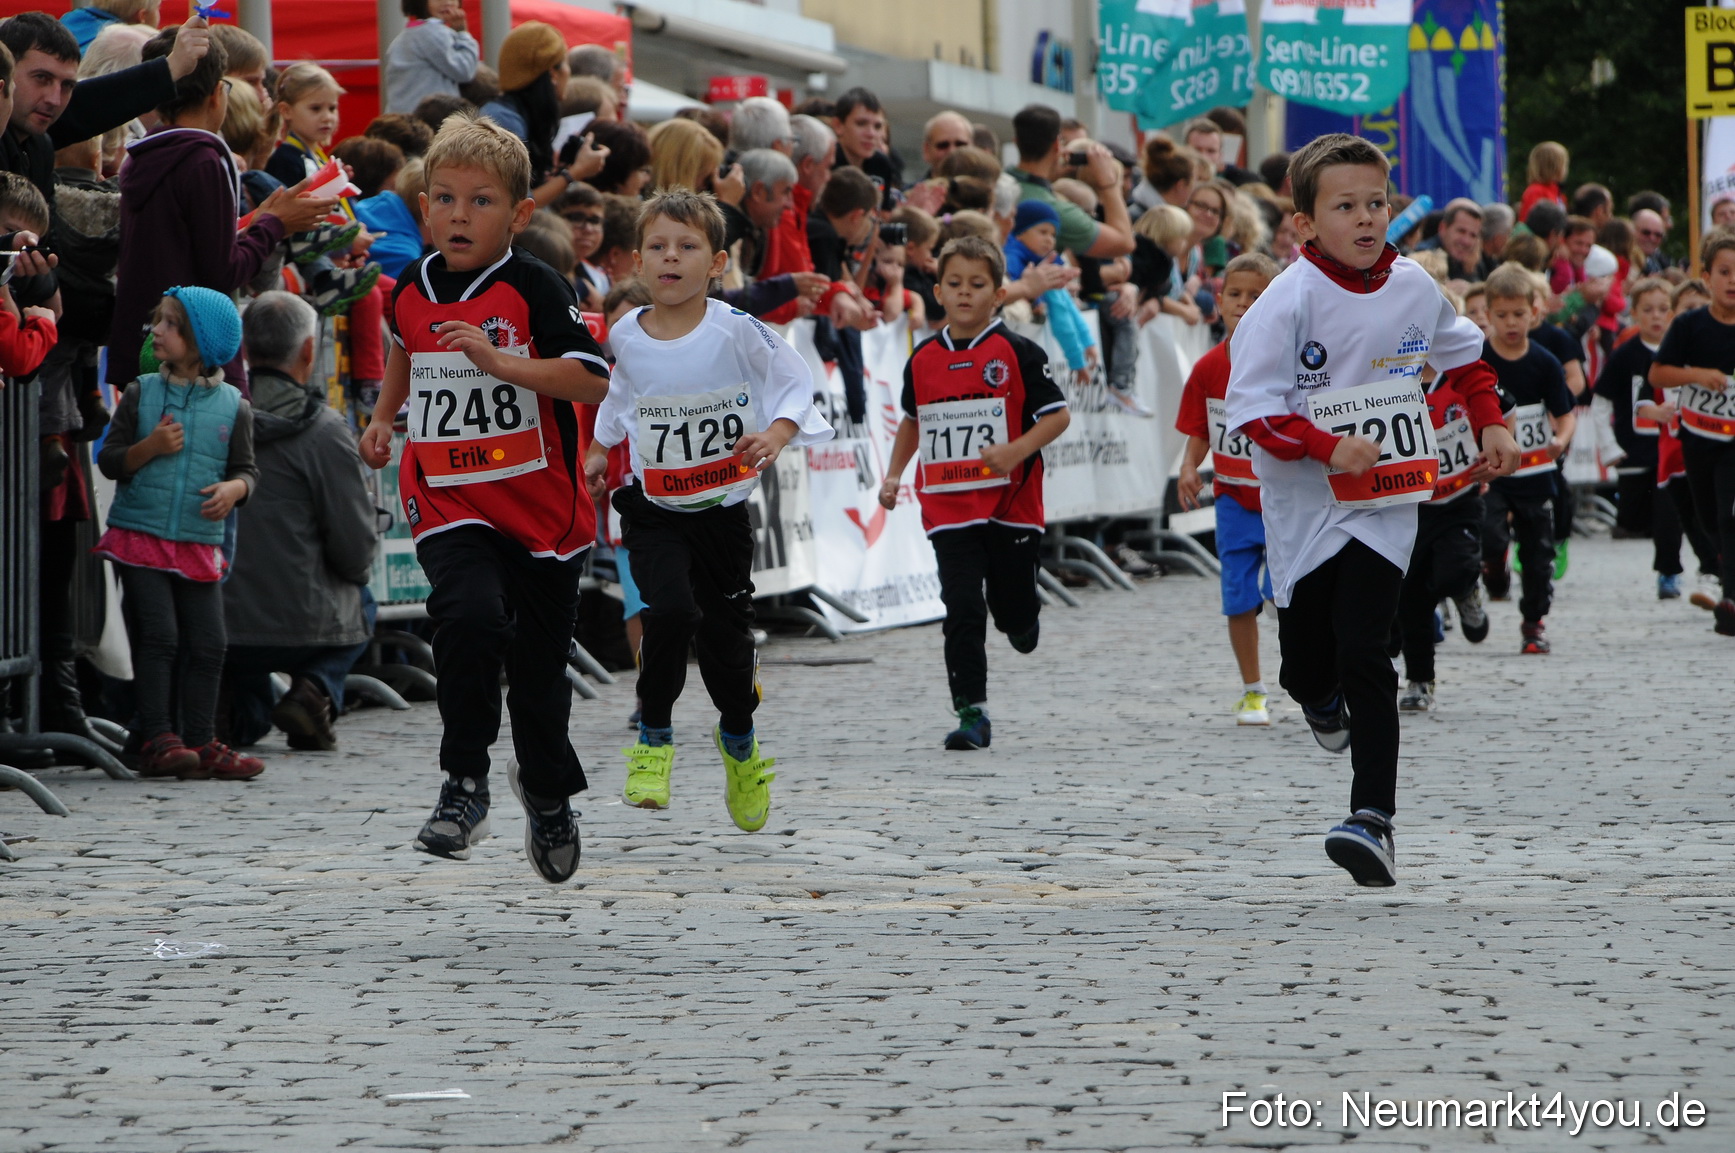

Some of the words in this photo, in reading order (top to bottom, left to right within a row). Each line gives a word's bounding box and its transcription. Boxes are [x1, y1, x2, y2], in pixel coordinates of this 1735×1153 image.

[1707, 41, 1735, 92] B
[411, 367, 437, 380] PARTL
[439, 366, 490, 379] Neumar
[1371, 358, 1388, 370] 14.
[1296, 372, 1331, 383] PARTL
[1297, 380, 1331, 390] Neumarkt
[418, 384, 522, 438] 7248
[640, 407, 677, 418] PARTL
[679, 399, 733, 416] Neumarkt
[920, 414, 941, 423] PARTL
[942, 409, 988, 420] Neumarkt
[1313, 400, 1363, 420] PARTL
[1364, 390, 1419, 410] Neumarkt
[650, 413, 744, 463] 7129
[927, 424, 996, 460] 7173
[449, 446, 489, 469] Erik
[662, 463, 738, 493] Christoph
[941, 466, 980, 481] Julian
[1371, 470, 1426, 493] Jonas
